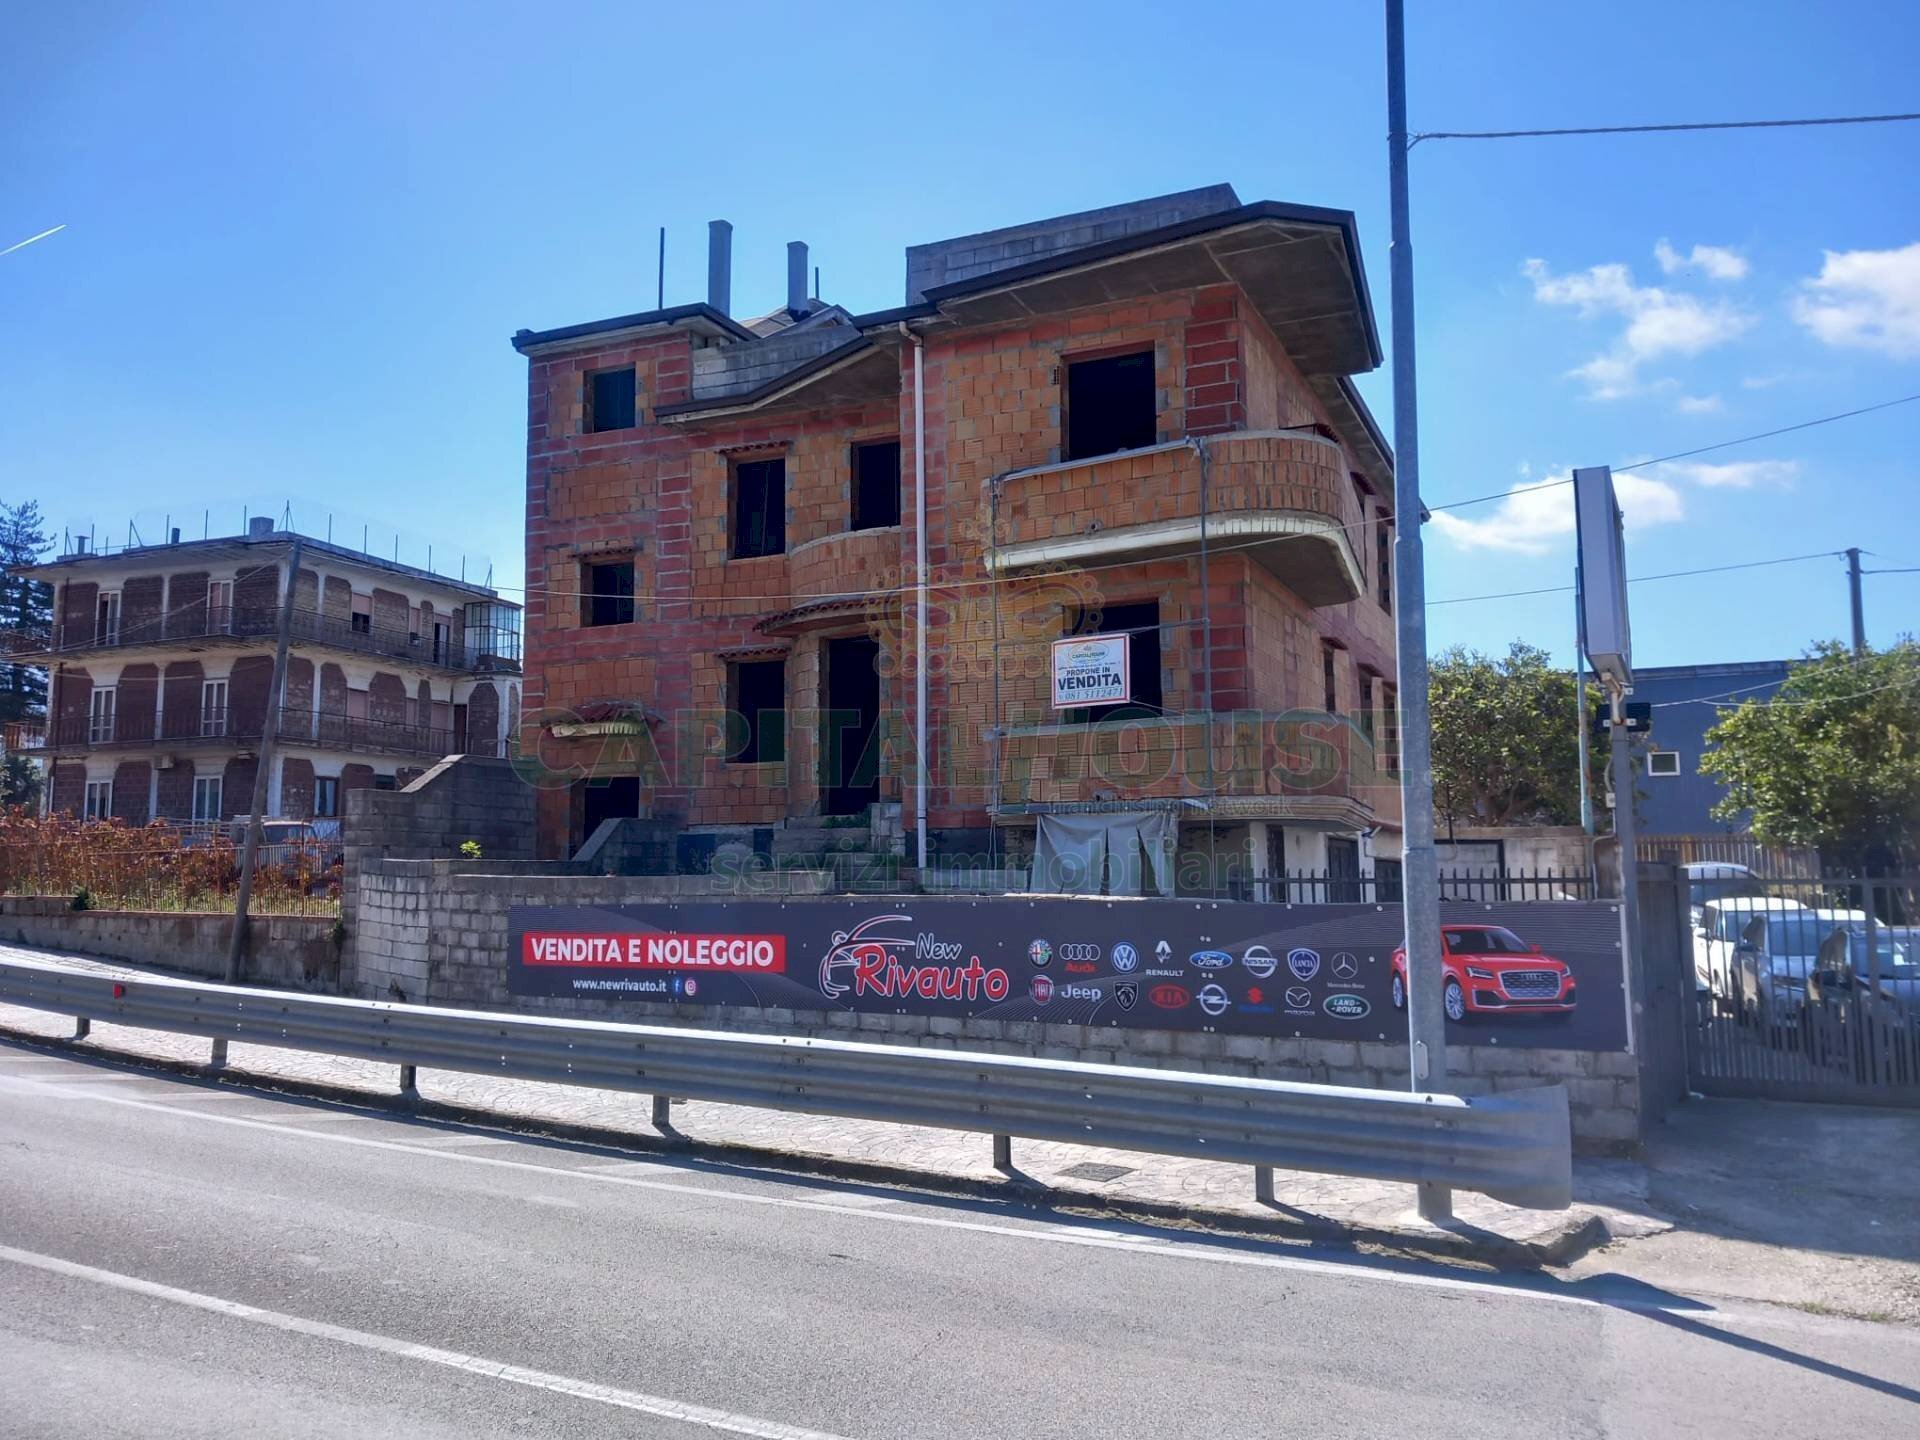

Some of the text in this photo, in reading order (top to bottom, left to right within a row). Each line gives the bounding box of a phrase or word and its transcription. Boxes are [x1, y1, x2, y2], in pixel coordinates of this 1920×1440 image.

[1067, 668, 1100, 676] PROPONE
[1102, 666, 1111, 674] IN
[1058, 673, 1122, 690] VENDITA
[531, 937, 774, 967] VENDITA E NOLEGGIO
[915, 932, 962, 960] New
[1198, 954, 1225, 966] Ford
[853, 944, 1010, 1001] Rivauto
[1145, 968, 1184, 977] RENAULT
[572, 978, 667, 993] www.newrivauto.it
[1061, 984, 1102, 1002] Jeep
[1156, 991, 1183, 1002] KIA
[1336, 1006, 1362, 1014] ROVER
